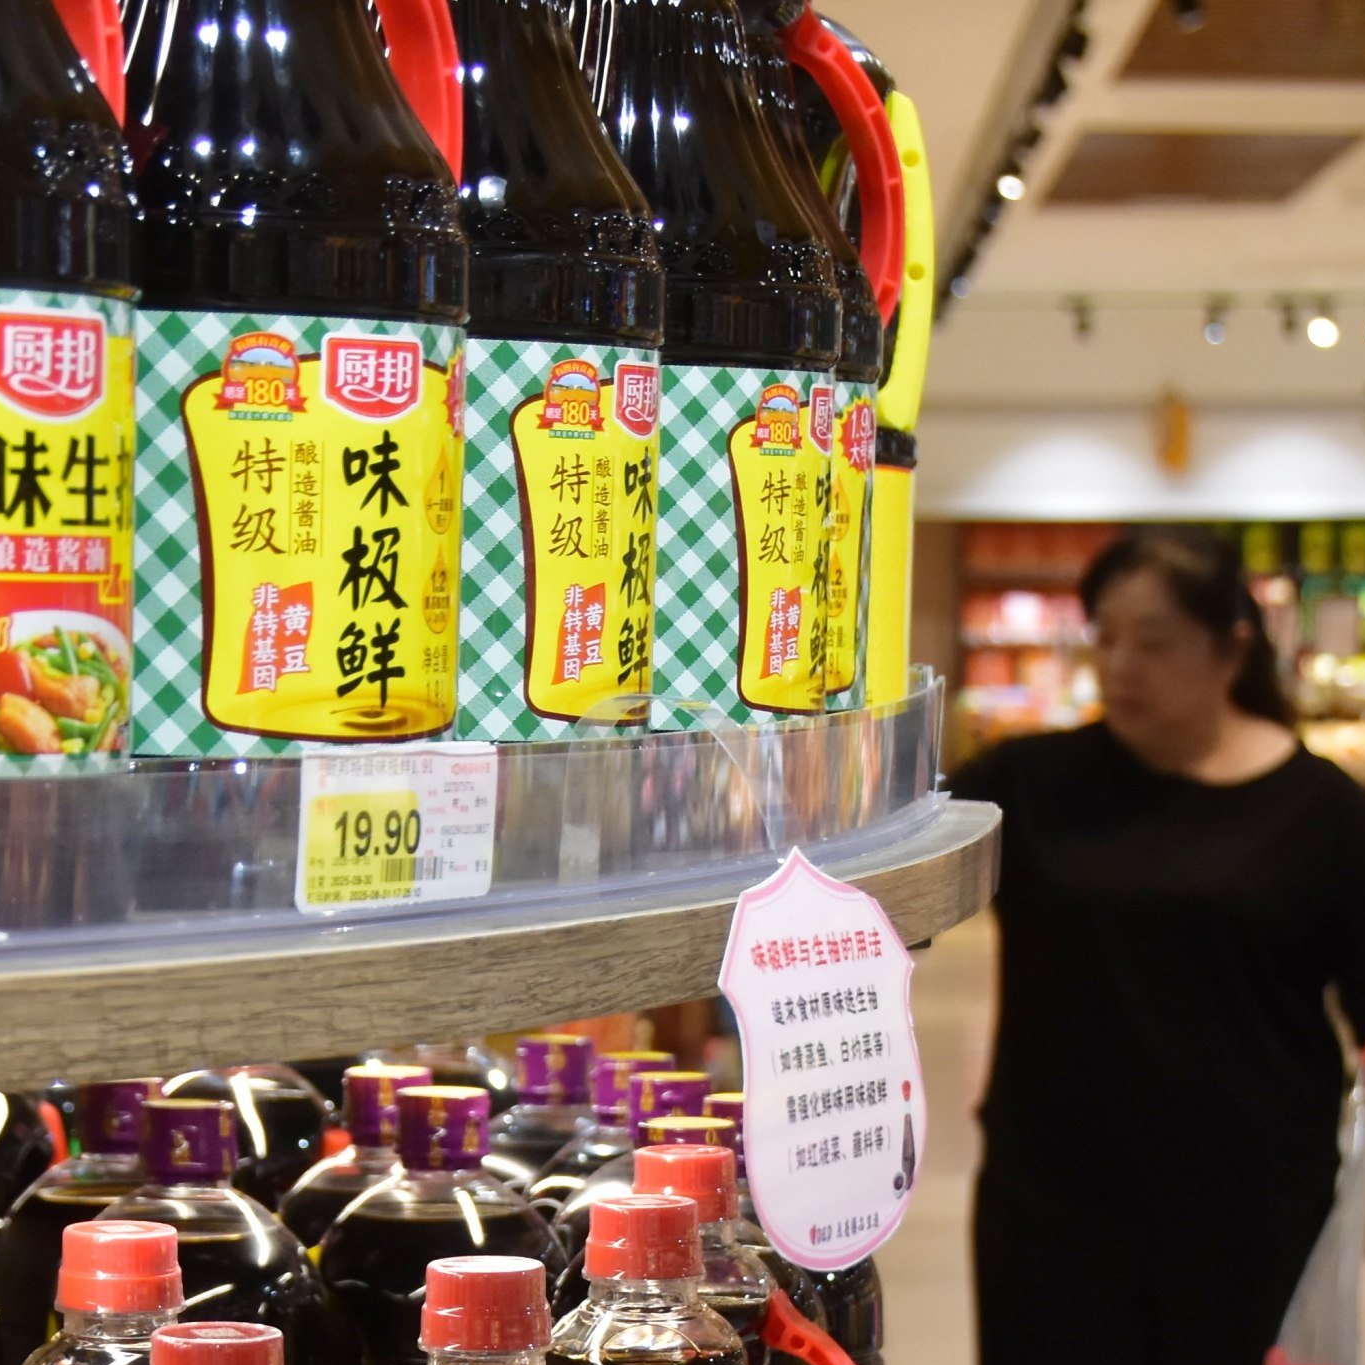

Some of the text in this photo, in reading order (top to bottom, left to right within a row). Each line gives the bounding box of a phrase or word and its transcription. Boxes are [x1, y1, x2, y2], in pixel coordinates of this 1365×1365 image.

[2, 324, 95, 399] 厨邦
[337, 350, 410, 402] 厨邦
[230, 436, 287, 555] 特级
[293, 443, 320, 556] 酿造酱油
[549, 453, 591, 560] 特级
[593, 457, 611, 560] 酿造酱油
[760, 469, 792, 564] 特级
[792, 472, 807, 564] 酿造酱油
[335, 429, 410, 708] 味极鲜
[617, 446, 654, 694] 味极鲜
[252, 582, 280, 691] 非转基因
[281, 604, 311, 675] 黄豆
[563, 583, 583, 681] 非转基因
[584, 603, 603, 665] 黄豆
[771, 587, 786, 676] 非转基因
[786, 602, 800, 662] 黄豆
[335, 809, 422, 857] 19.90
